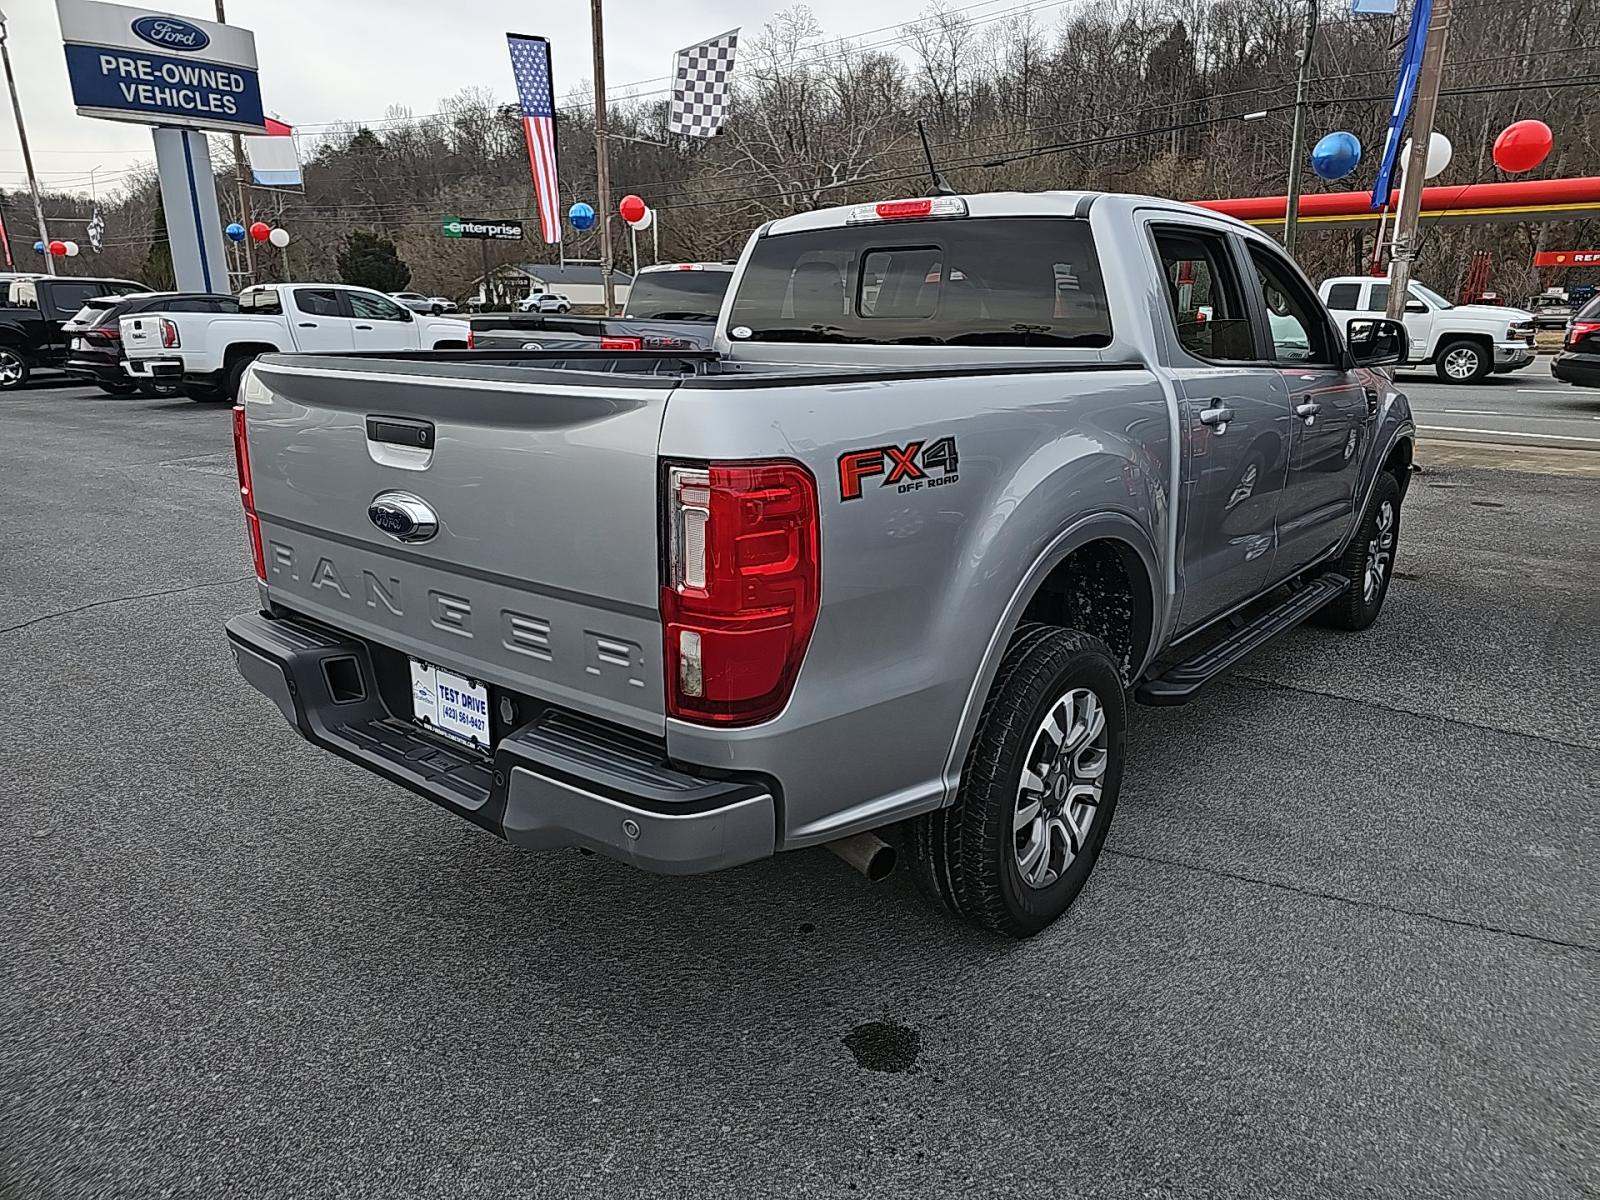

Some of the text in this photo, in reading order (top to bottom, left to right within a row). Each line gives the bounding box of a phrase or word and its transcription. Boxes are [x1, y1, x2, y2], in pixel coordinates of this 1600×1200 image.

[150, 21, 196, 46] Ford
[99, 55, 245, 93] PRE-OWNED
[118, 82, 237, 115] VEHICLES
[449, 222, 521, 236] enterprise
[837, 436, 959, 503] FX4
[897, 474, 960, 494] OFF ROAD
[267, 539, 646, 688] RANGER
[438, 684, 460, 705] TEST
[461, 692, 487, 716] DRIVE
